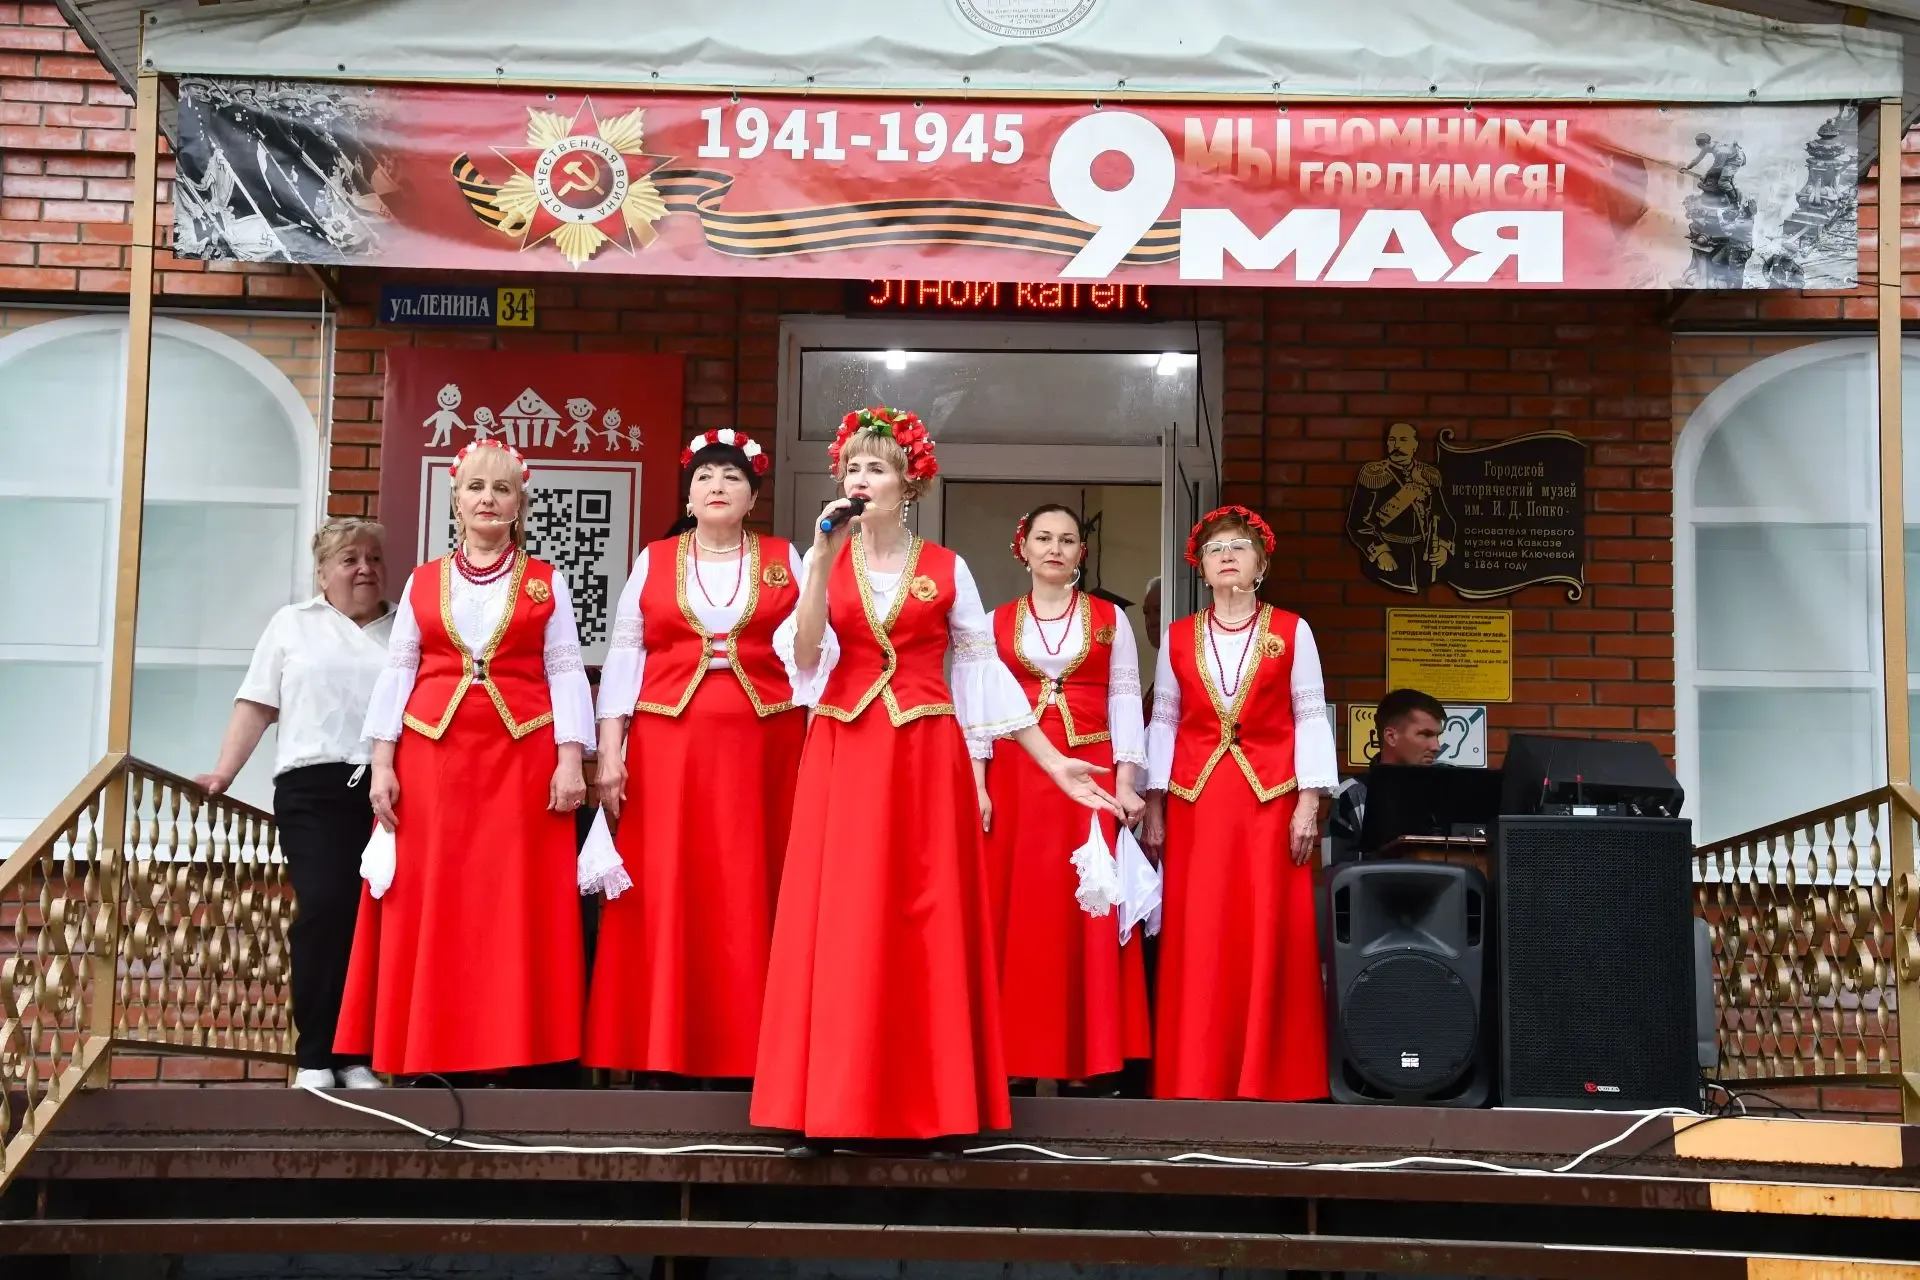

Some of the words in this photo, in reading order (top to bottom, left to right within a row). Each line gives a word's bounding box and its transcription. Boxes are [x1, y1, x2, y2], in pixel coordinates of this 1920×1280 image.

[698, 107, 1024, 165] 1941-1945
[1184, 118, 1291, 185] МЫ
[538, 139, 618, 213] ОТЕЧЕСТВЕННАЯ
[1049, 112, 1176, 278] 9
[1179, 208, 1564, 283] МАЯ
[1484, 460, 1545, 479] Городской
[1452, 482, 1533, 499] исторический
[1541, 483, 1577, 500] музей
[1464, 504, 1484, 516] им.
[1509, 501, 1522, 519] Д.
[1527, 501, 1564, 517] Попко
[1464, 528, 1527, 536] основателя
[1530, 528, 1575, 538] первого
[1464, 540, 1496, 550] музея
[1500, 540, 1514, 548] на
[1518, 539, 1562, 548] Кавказе
[1464, 551, 1470, 559] в
[1474, 551, 1518, 560] станице
[1521, 549, 1575, 560] Ключевой
[1464, 562, 1470, 570] в
[1475, 560, 1500, 570] 1864
[1504, 562, 1528, 571] году
